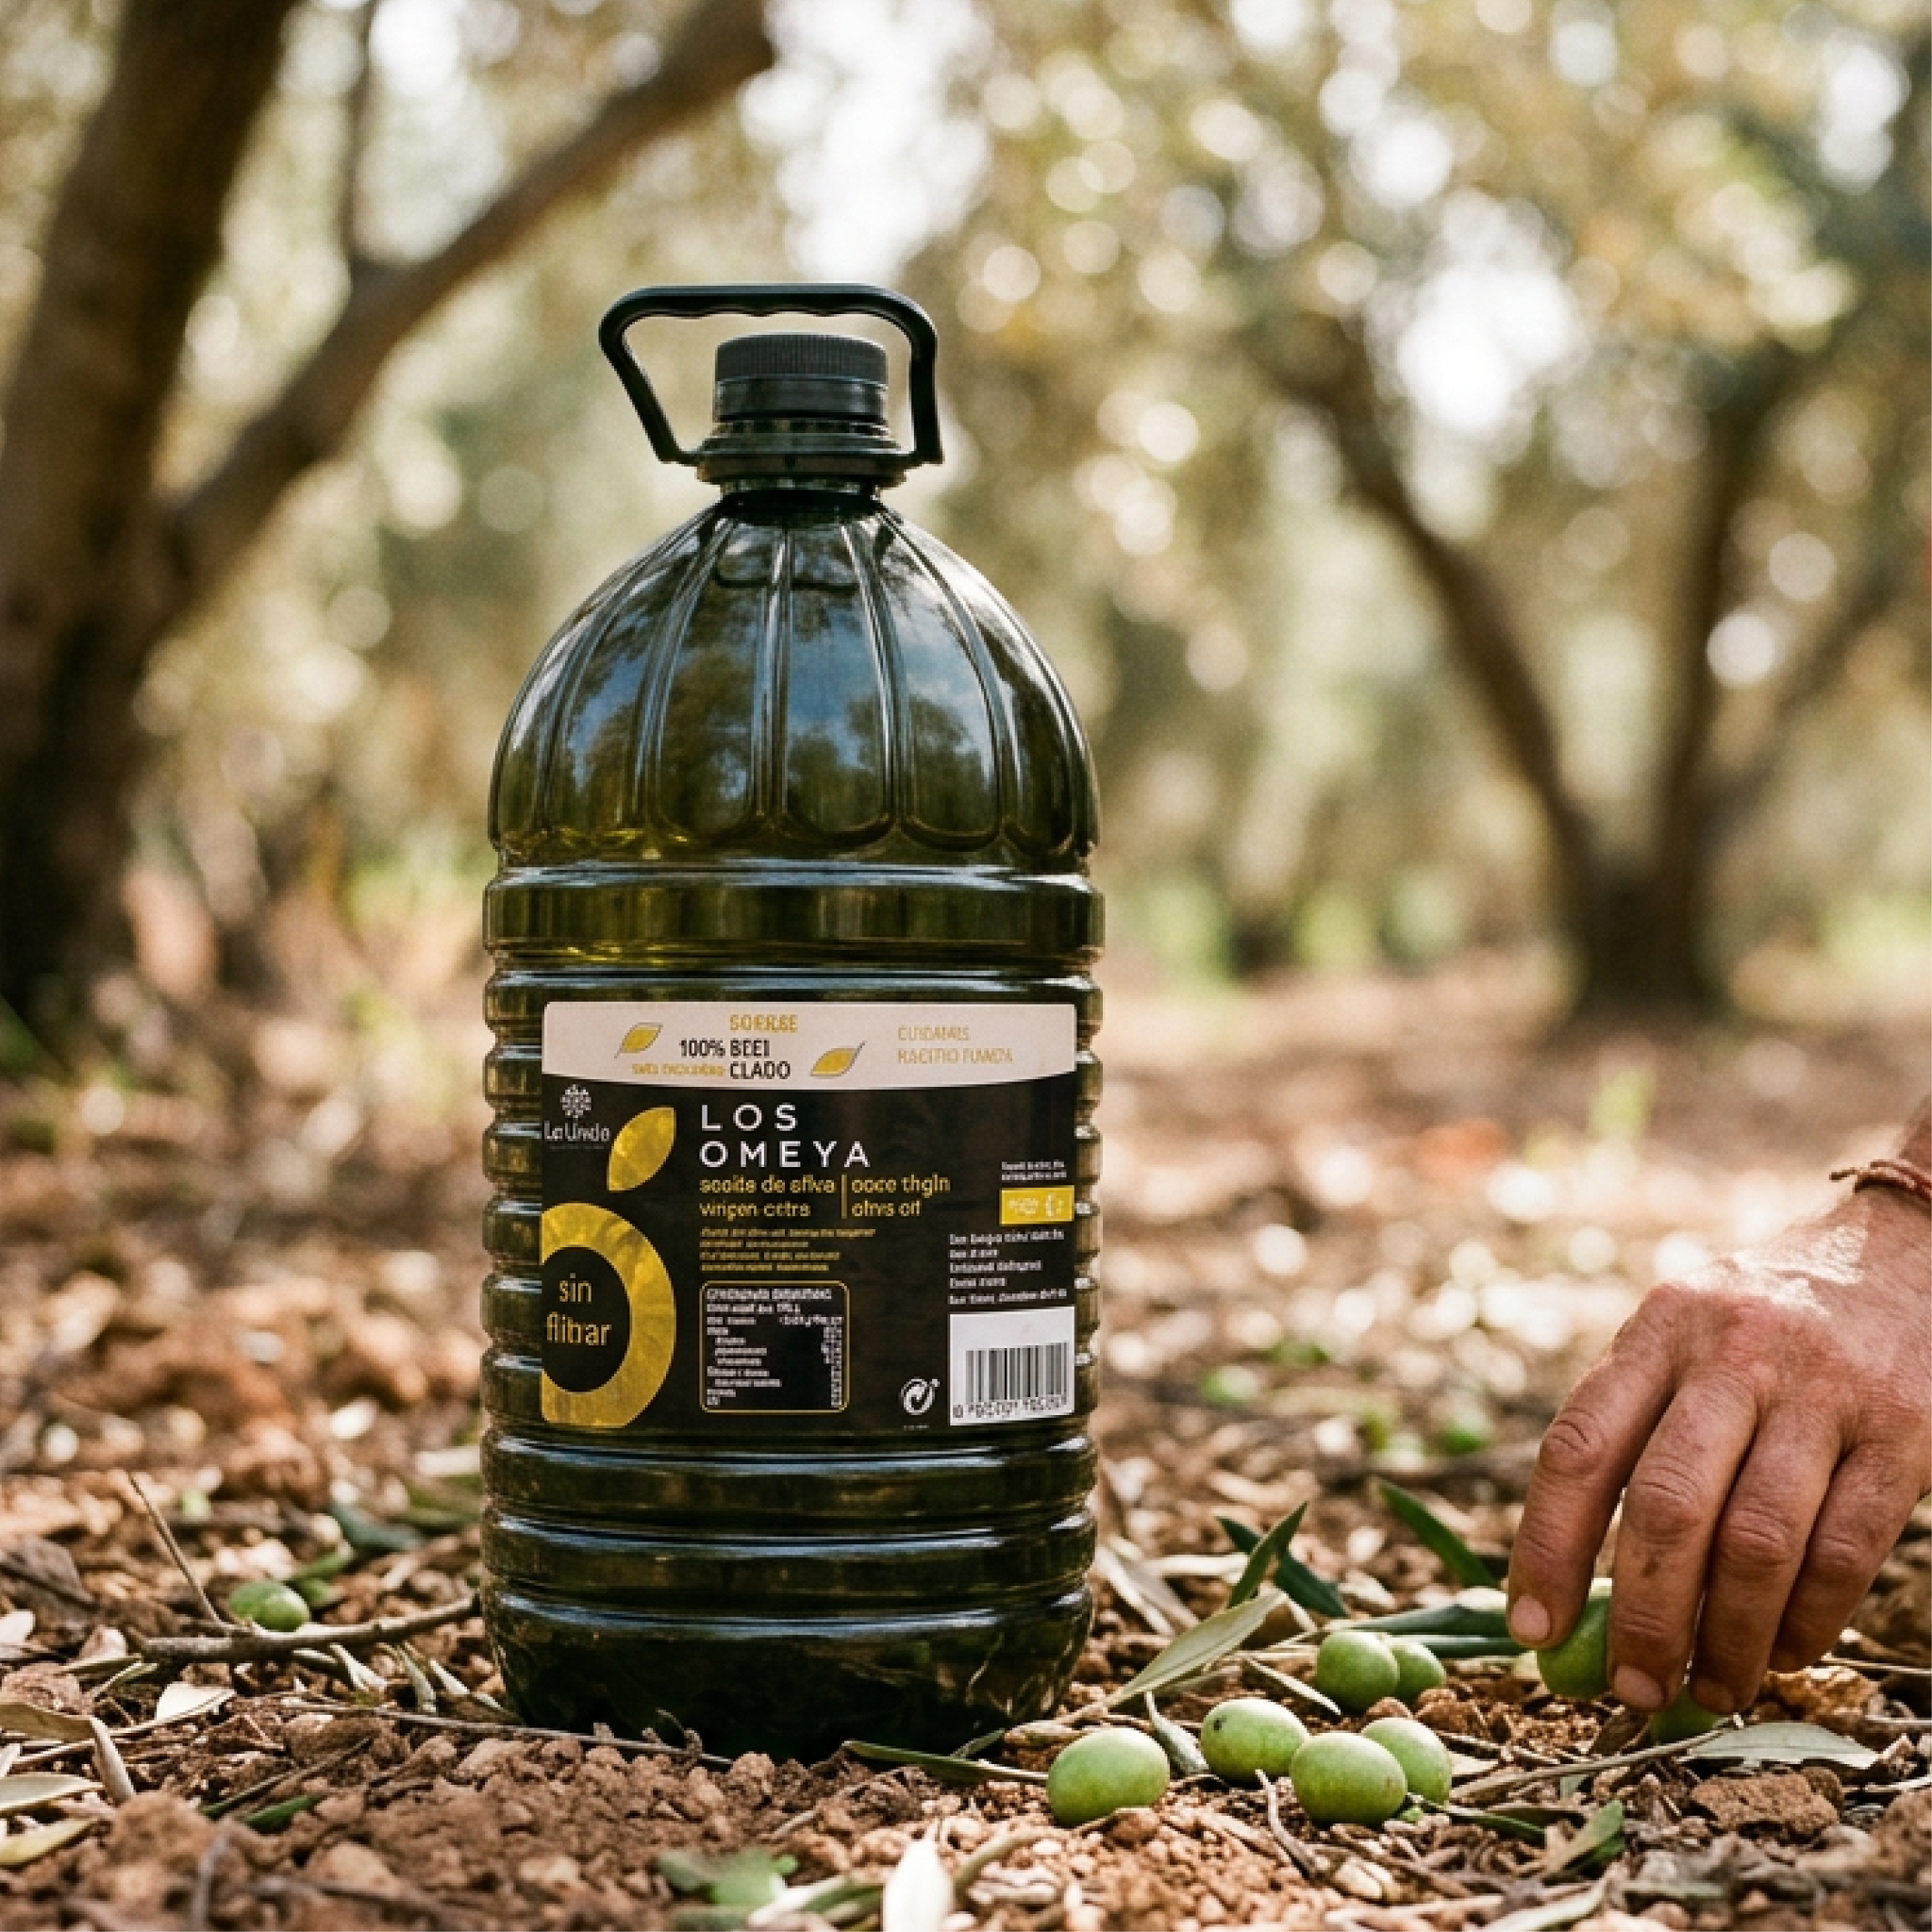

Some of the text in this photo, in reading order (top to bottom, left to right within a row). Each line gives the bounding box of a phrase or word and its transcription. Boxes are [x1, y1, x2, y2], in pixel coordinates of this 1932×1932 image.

[679, 1038, 725, 1058] 100%
[701, 1103, 798, 1131] LOS
[699, 1141, 871, 1168] OMEYA
[559, 1273, 591, 1303] sin
